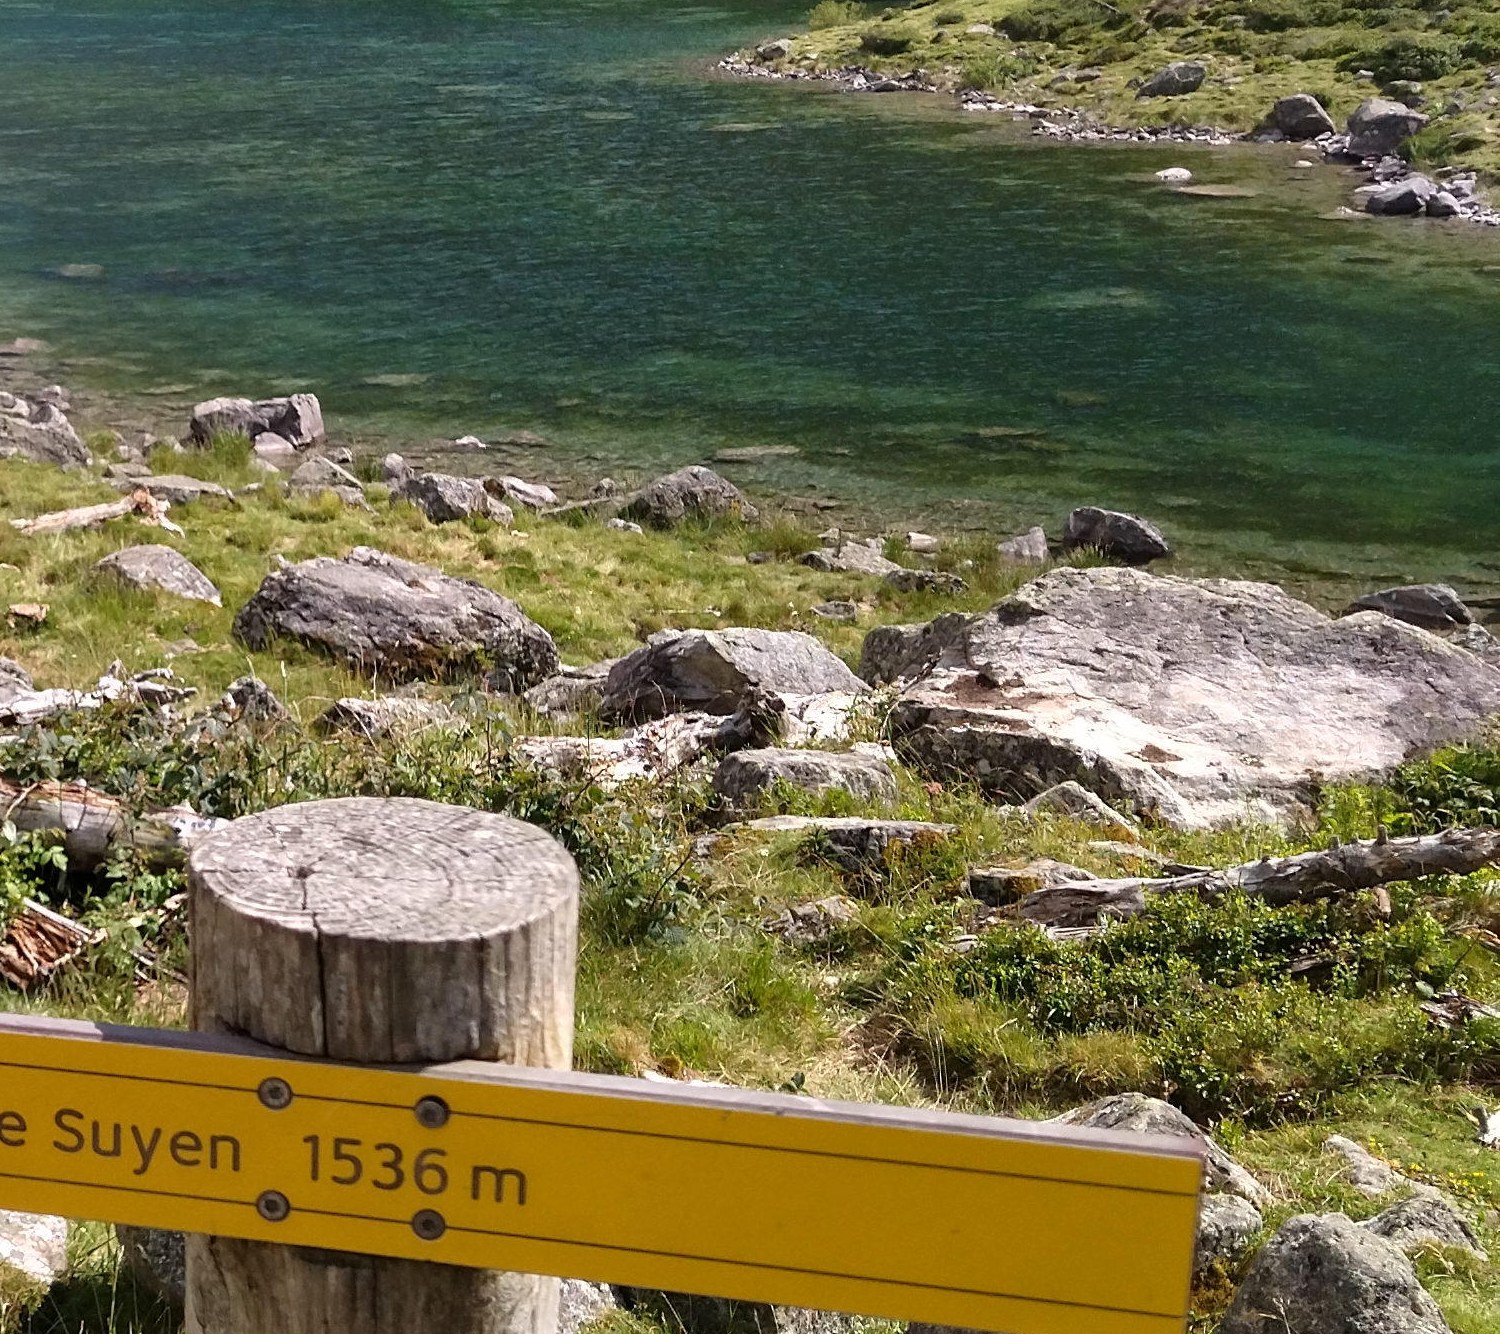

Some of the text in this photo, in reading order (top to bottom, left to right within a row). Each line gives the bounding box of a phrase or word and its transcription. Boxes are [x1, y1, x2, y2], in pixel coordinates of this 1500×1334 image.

[52, 1107, 242, 1177] Suyen
[302, 1133, 450, 1197] 1536
[469, 1163, 529, 1207] m
